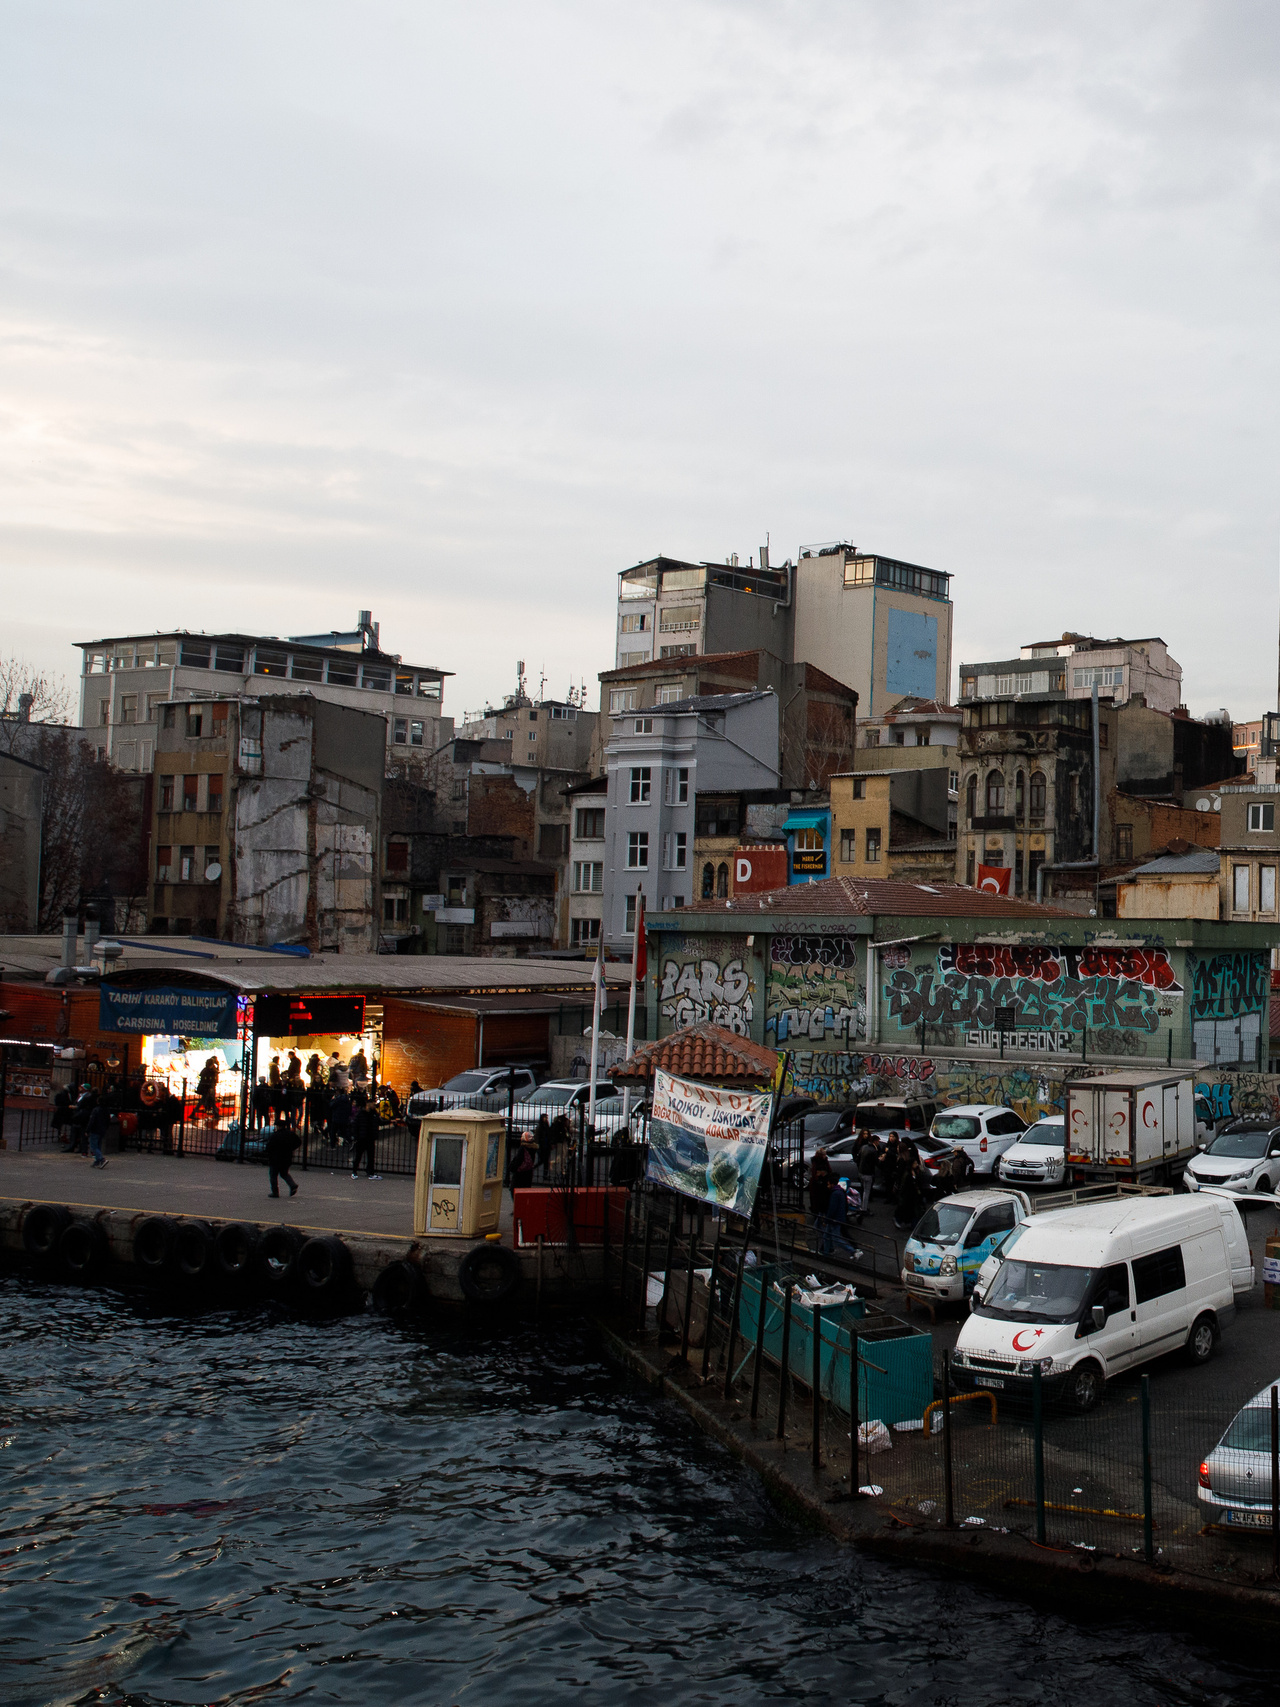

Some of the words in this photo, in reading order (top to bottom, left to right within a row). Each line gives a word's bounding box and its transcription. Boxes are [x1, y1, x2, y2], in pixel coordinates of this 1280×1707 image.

[737, 859, 752, 882] D
[657, 959, 749, 1005] PARS
[144, 994, 180, 1007] KARAKÖY
[667, 1076, 756, 1112] TURYOL
[711, 1107, 757, 1130] ÜSKÜDAR
[705, 1124, 740, 1141] ADALAR
